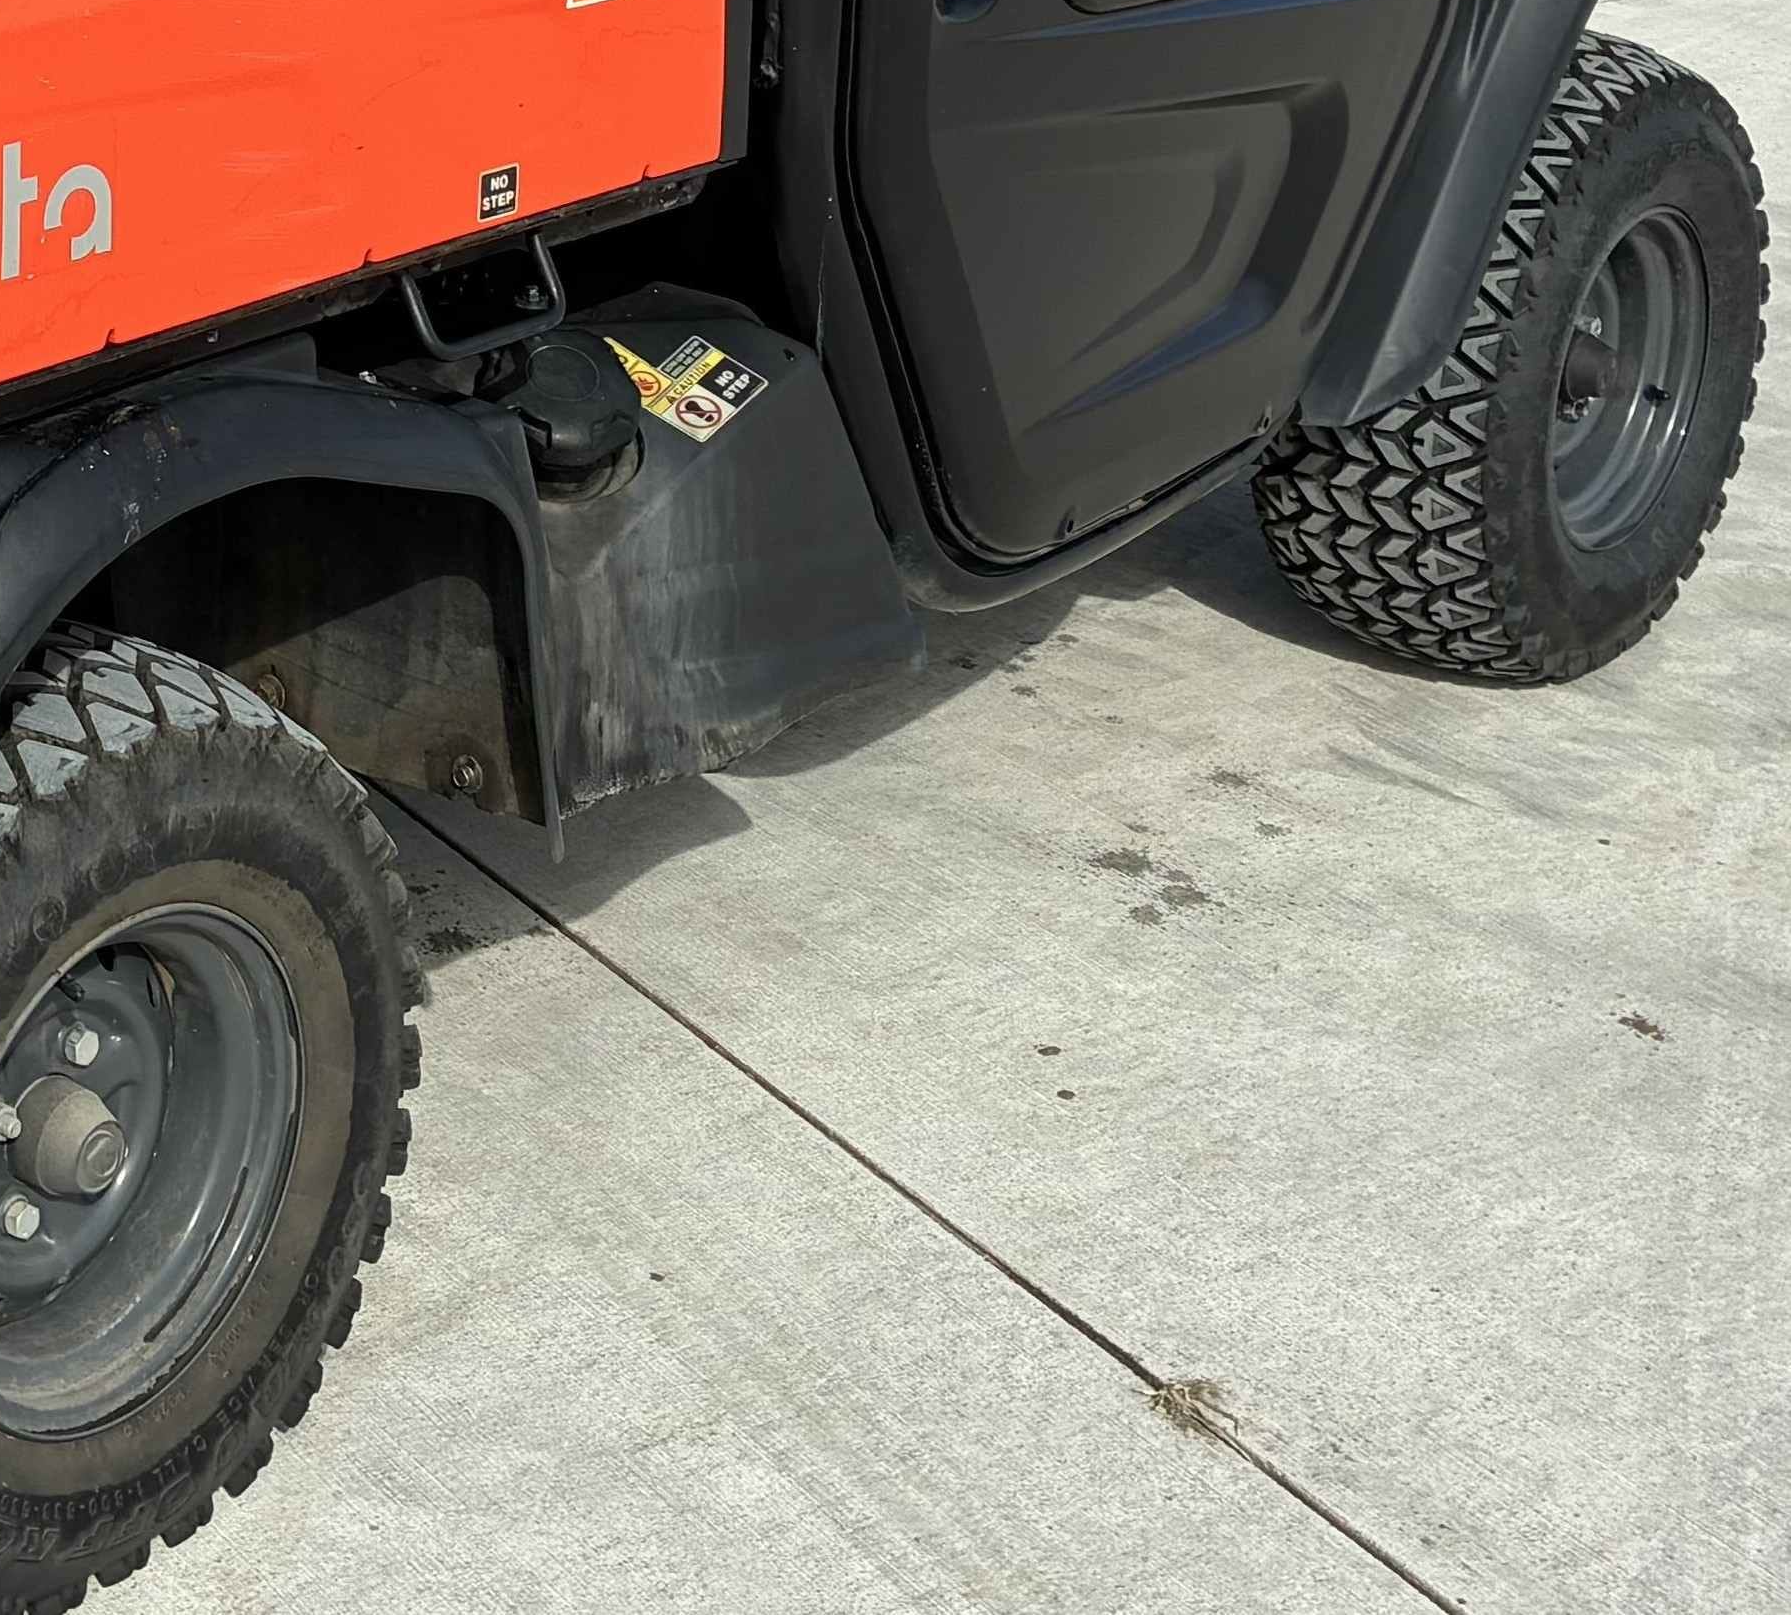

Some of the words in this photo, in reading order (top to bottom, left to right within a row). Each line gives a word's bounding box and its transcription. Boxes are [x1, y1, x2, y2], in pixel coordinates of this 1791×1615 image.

[490, 173, 509, 192] NO
[482, 190, 515, 211] STEP
[672, 361, 712, 396] CAUTION
[714, 369, 736, 387] NO
[722, 373, 751, 400] STEP
